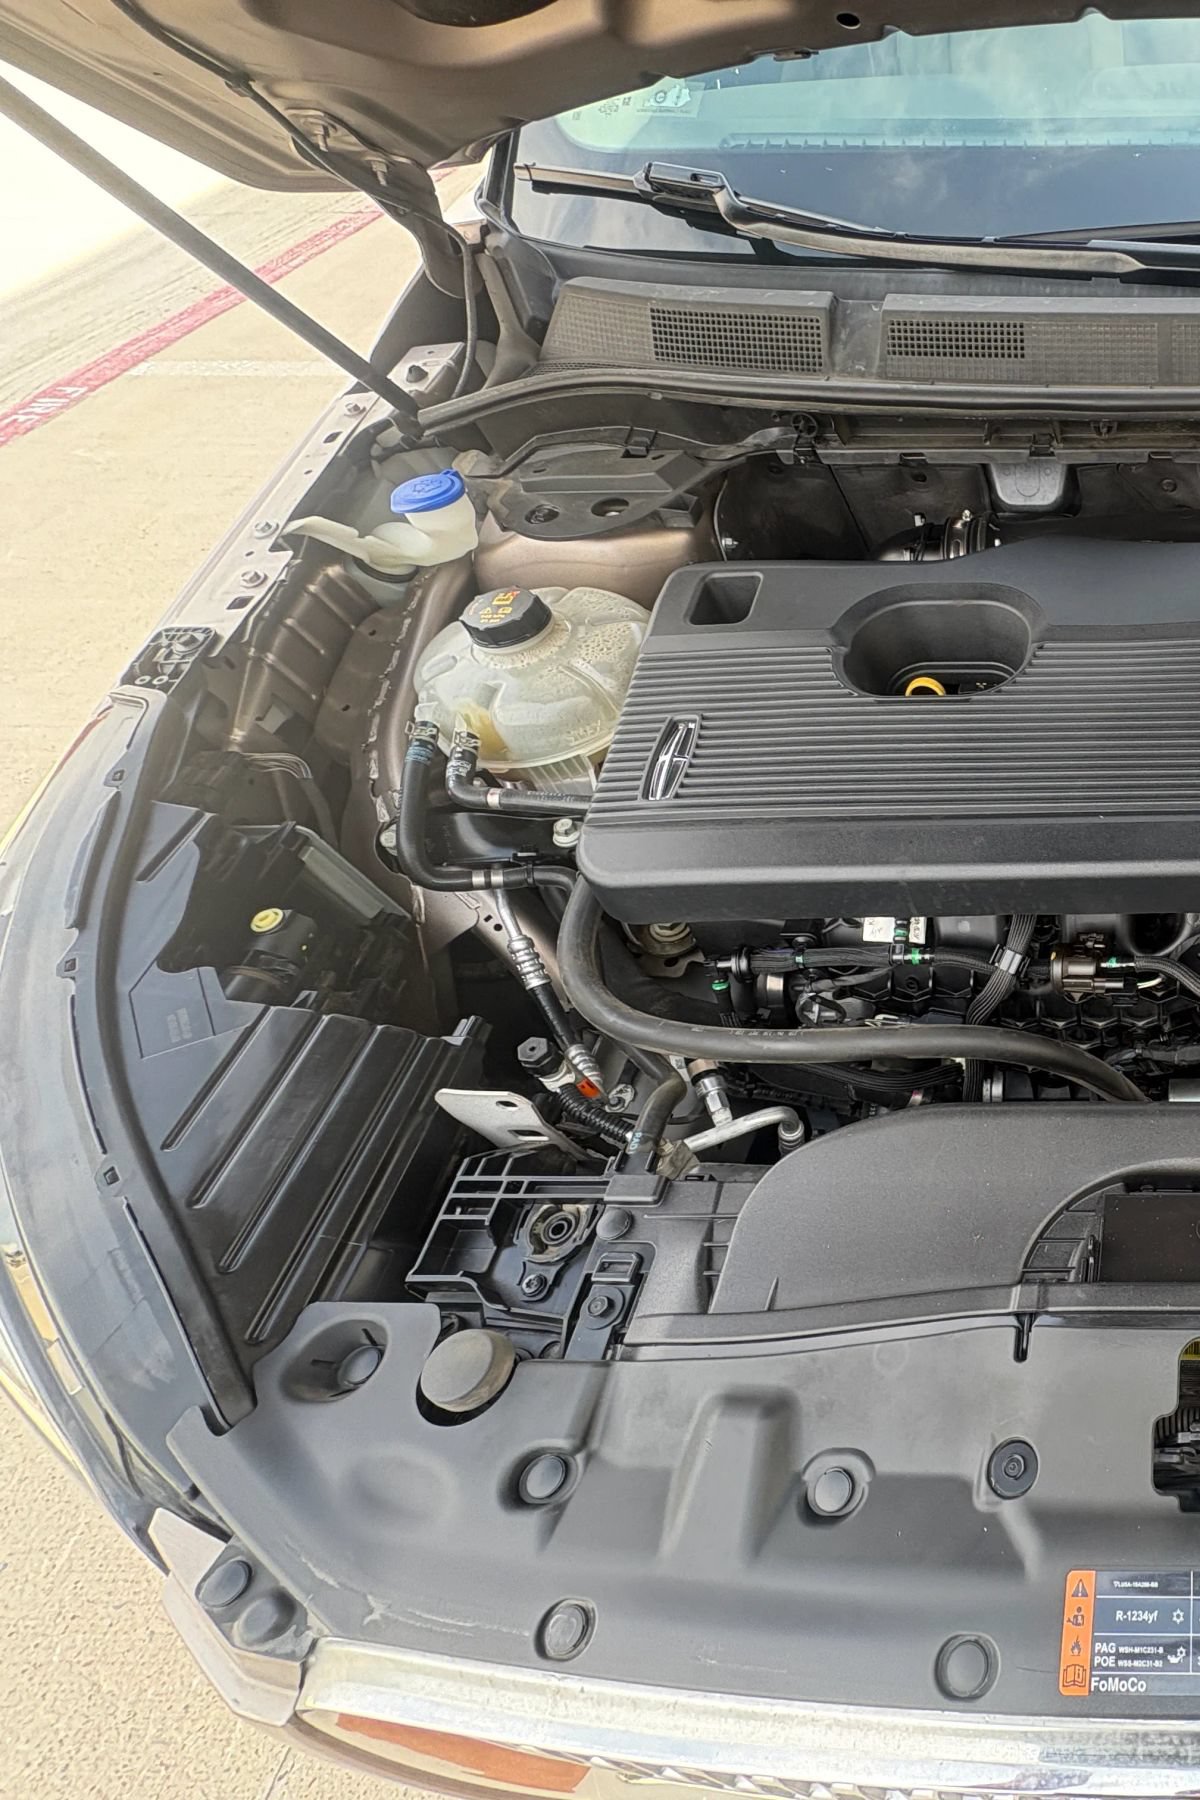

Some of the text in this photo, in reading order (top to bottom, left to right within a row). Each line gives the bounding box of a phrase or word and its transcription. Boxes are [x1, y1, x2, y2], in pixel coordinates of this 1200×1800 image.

[1115, 1610, 1158, 1624] R-1234yf
[1094, 1642, 1116, 1654] PAG
[1094, 1656, 1116, 1667] POE
[1090, 1677, 1147, 1692] FoMoCo
